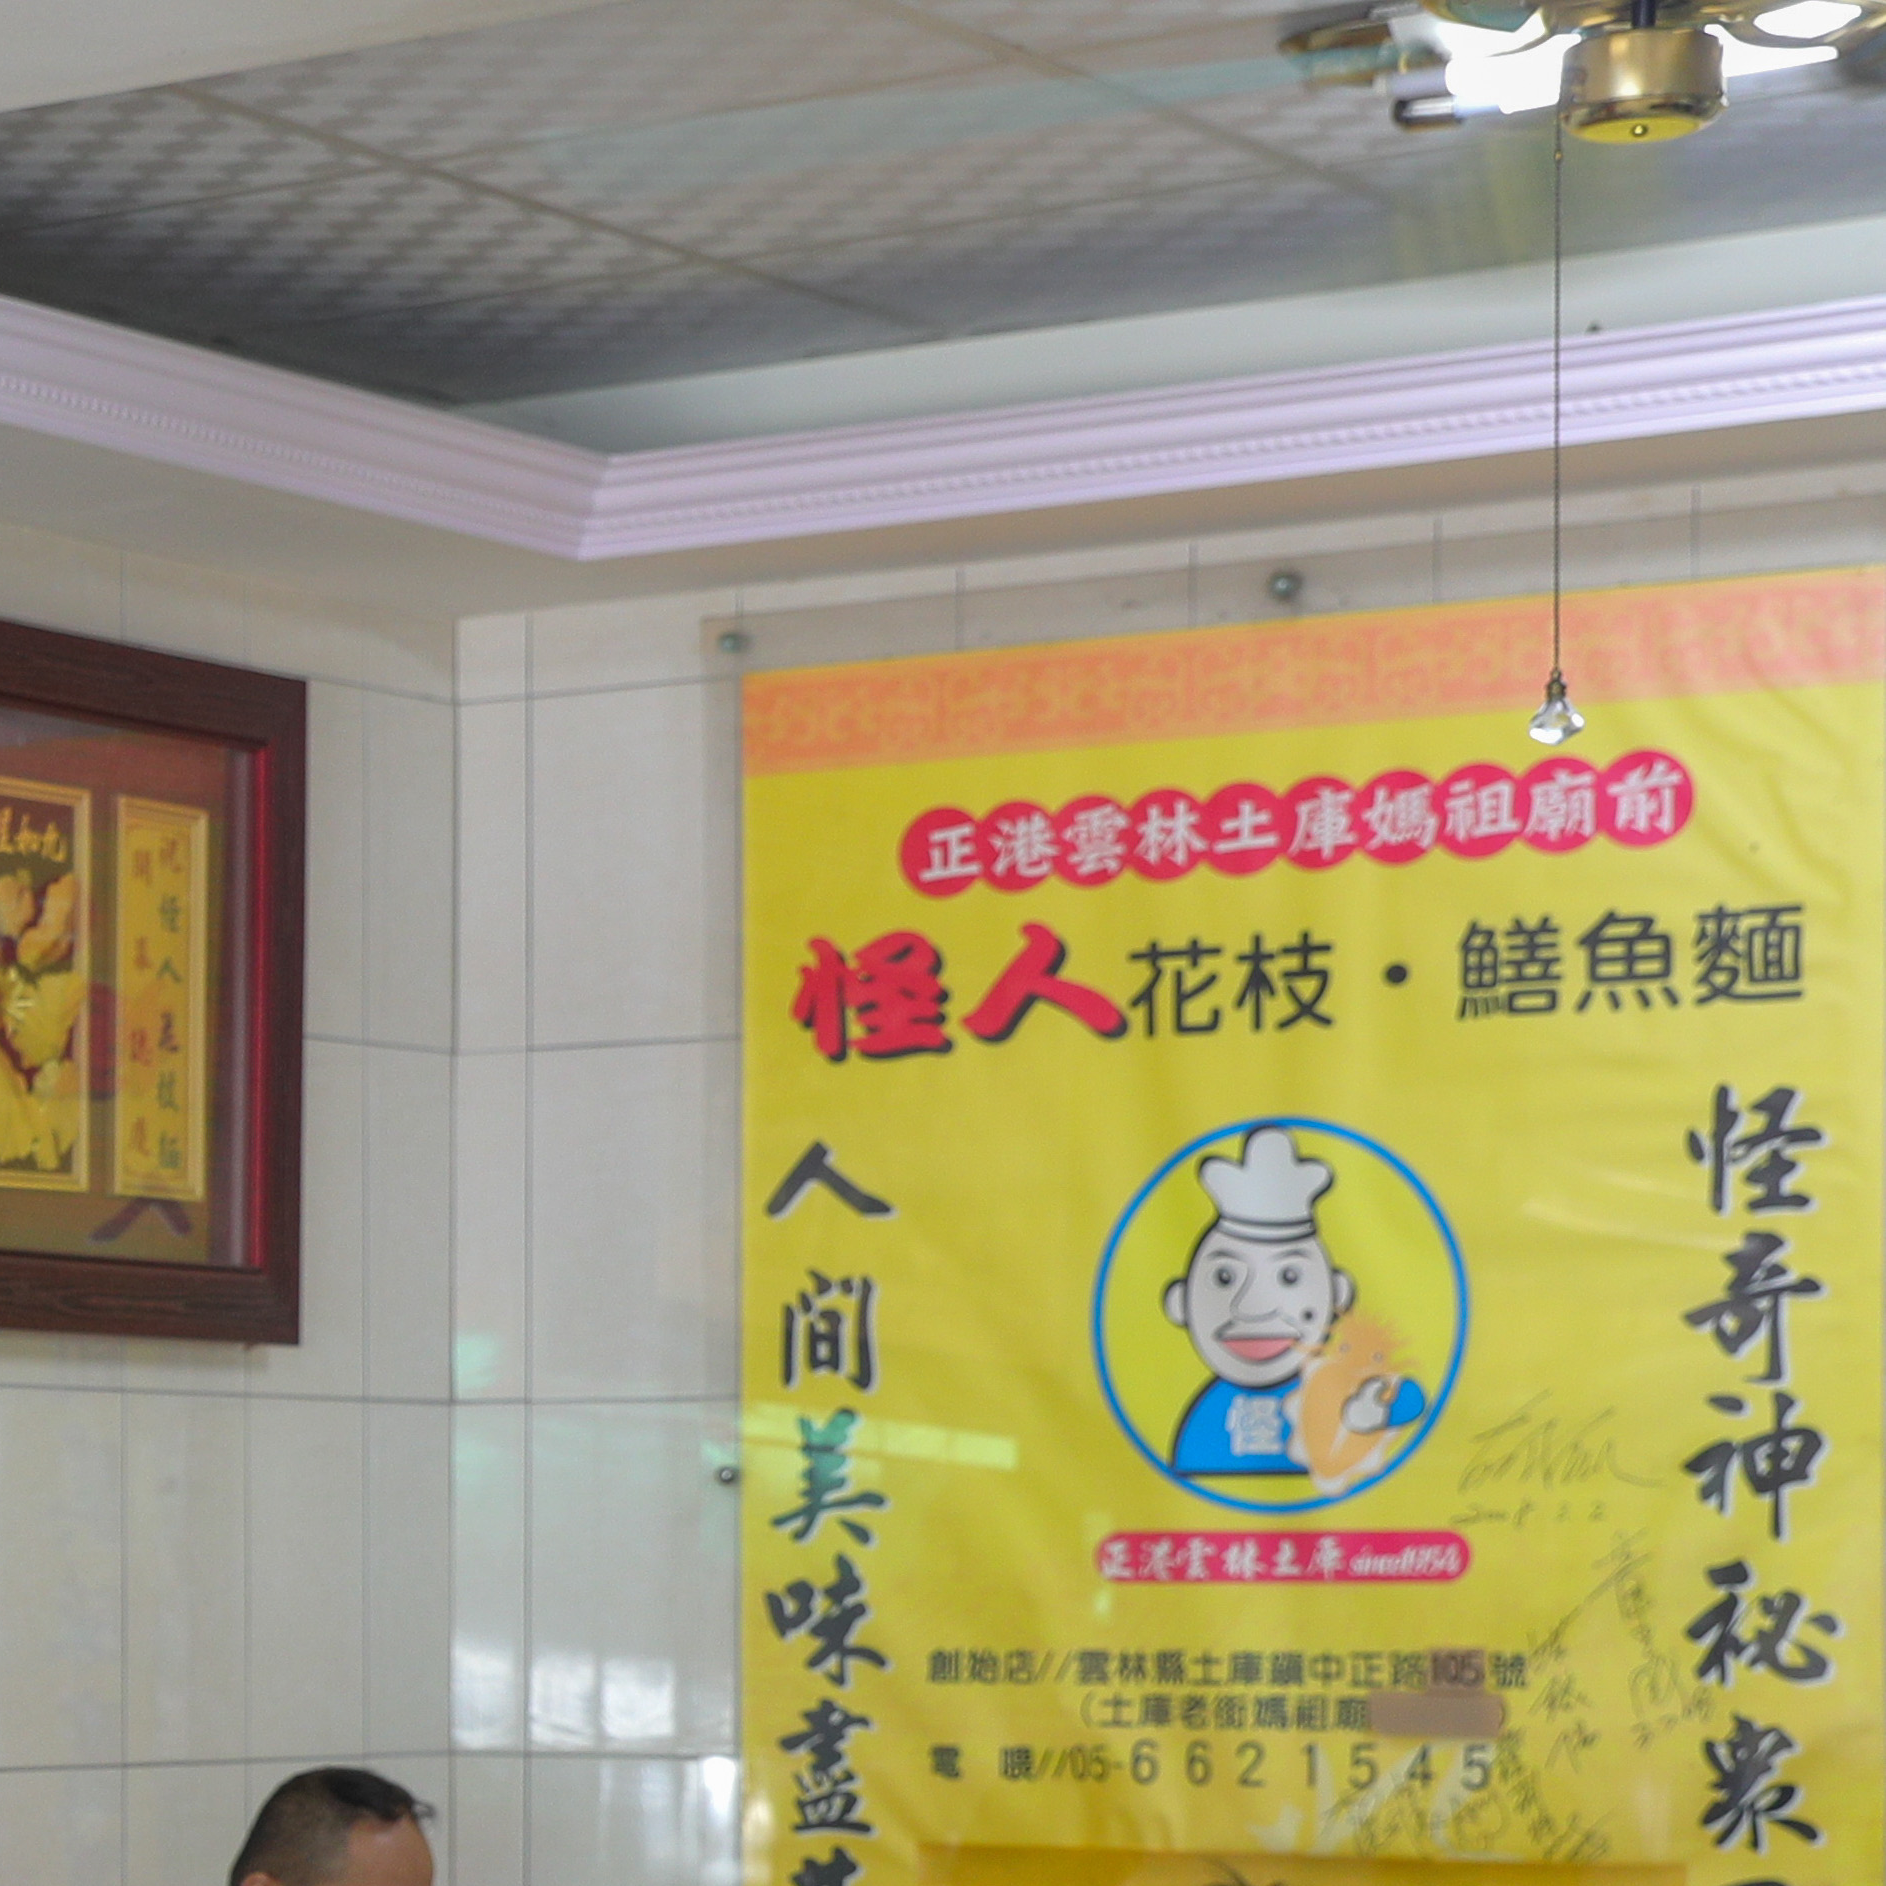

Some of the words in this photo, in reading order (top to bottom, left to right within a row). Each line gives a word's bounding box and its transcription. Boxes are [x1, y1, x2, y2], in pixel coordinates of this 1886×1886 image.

[917, 761, 1685, 883] 正港雲林土庫媽祖廟前
[789, 921, 1129, 1063] 怪人
